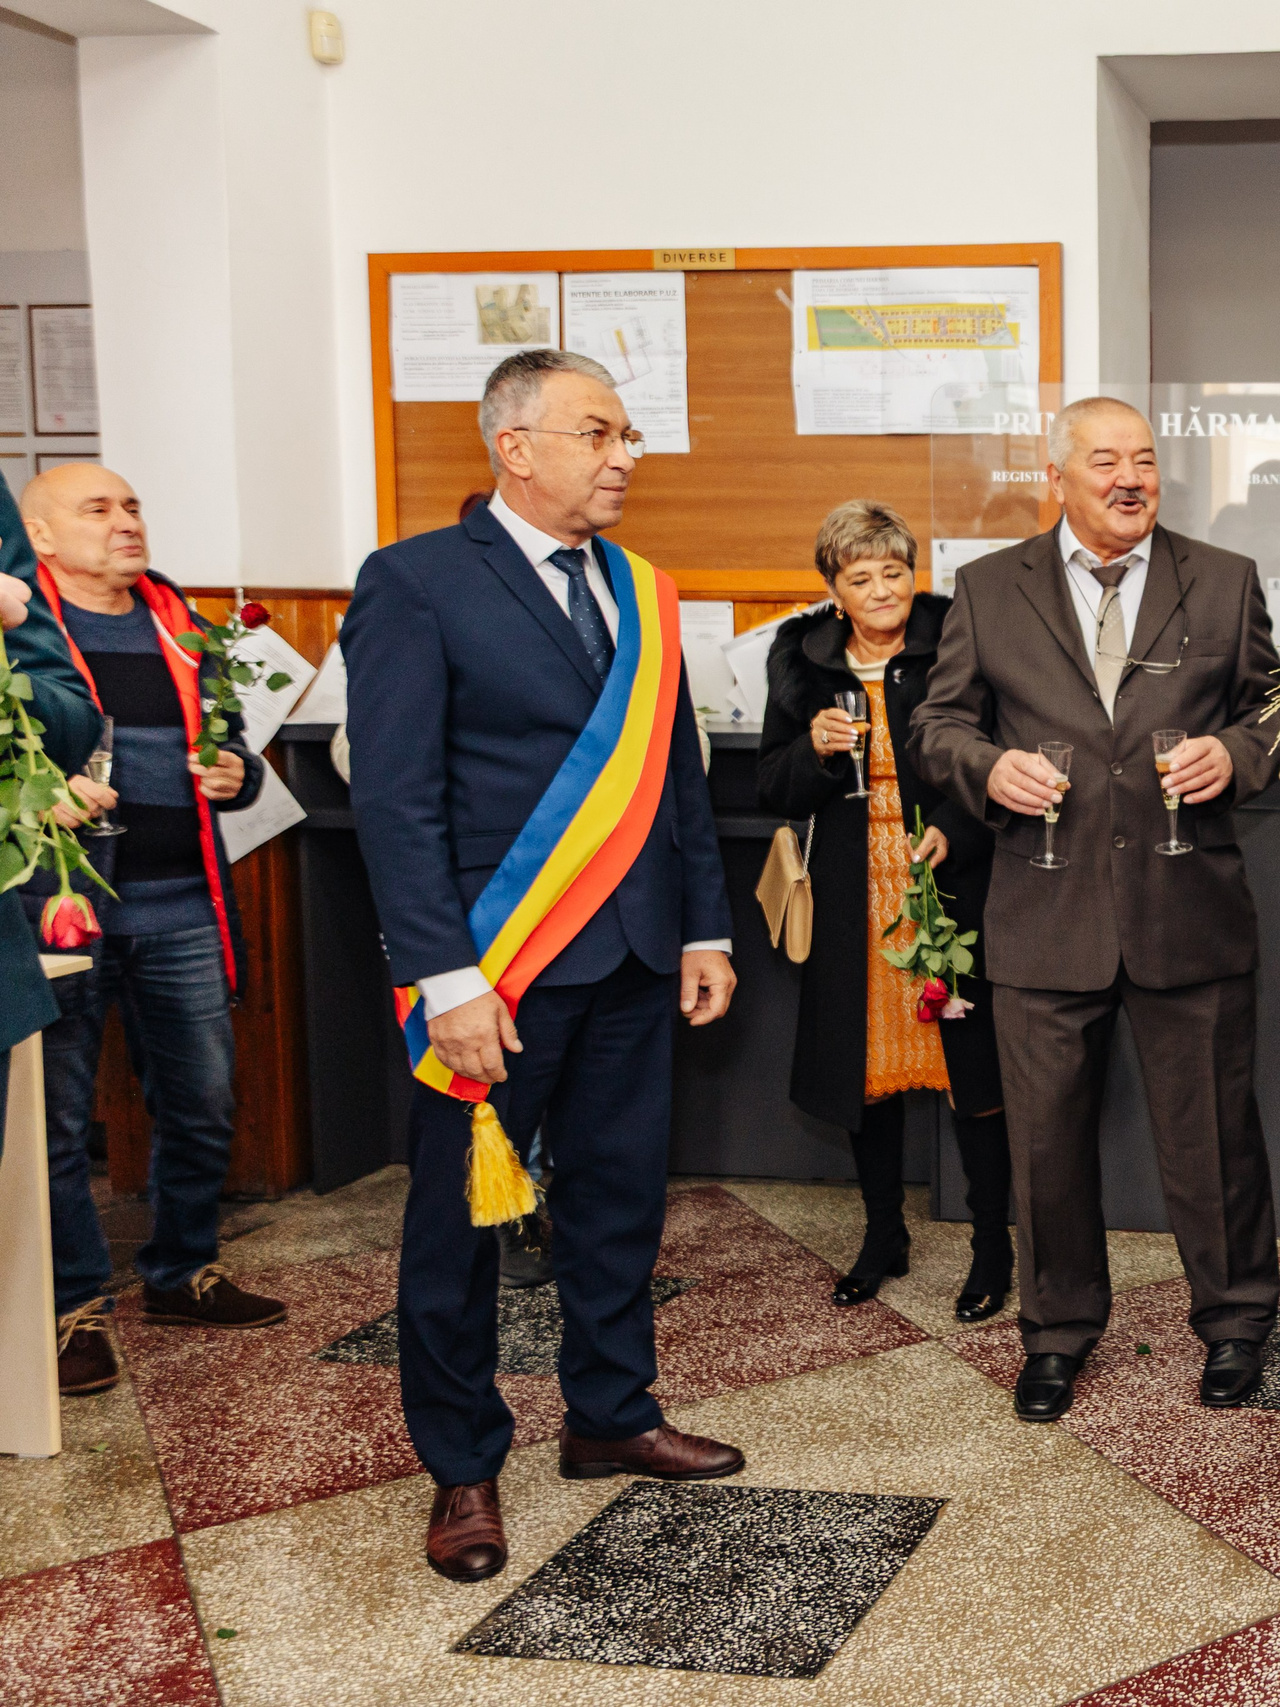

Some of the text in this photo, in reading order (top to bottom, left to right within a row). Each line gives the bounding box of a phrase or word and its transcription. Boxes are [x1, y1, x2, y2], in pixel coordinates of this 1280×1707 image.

[663, 252, 727, 264] DIVERSE
[603, 290, 613, 298] DE
[614, 289, 658, 298] ELABORARE
